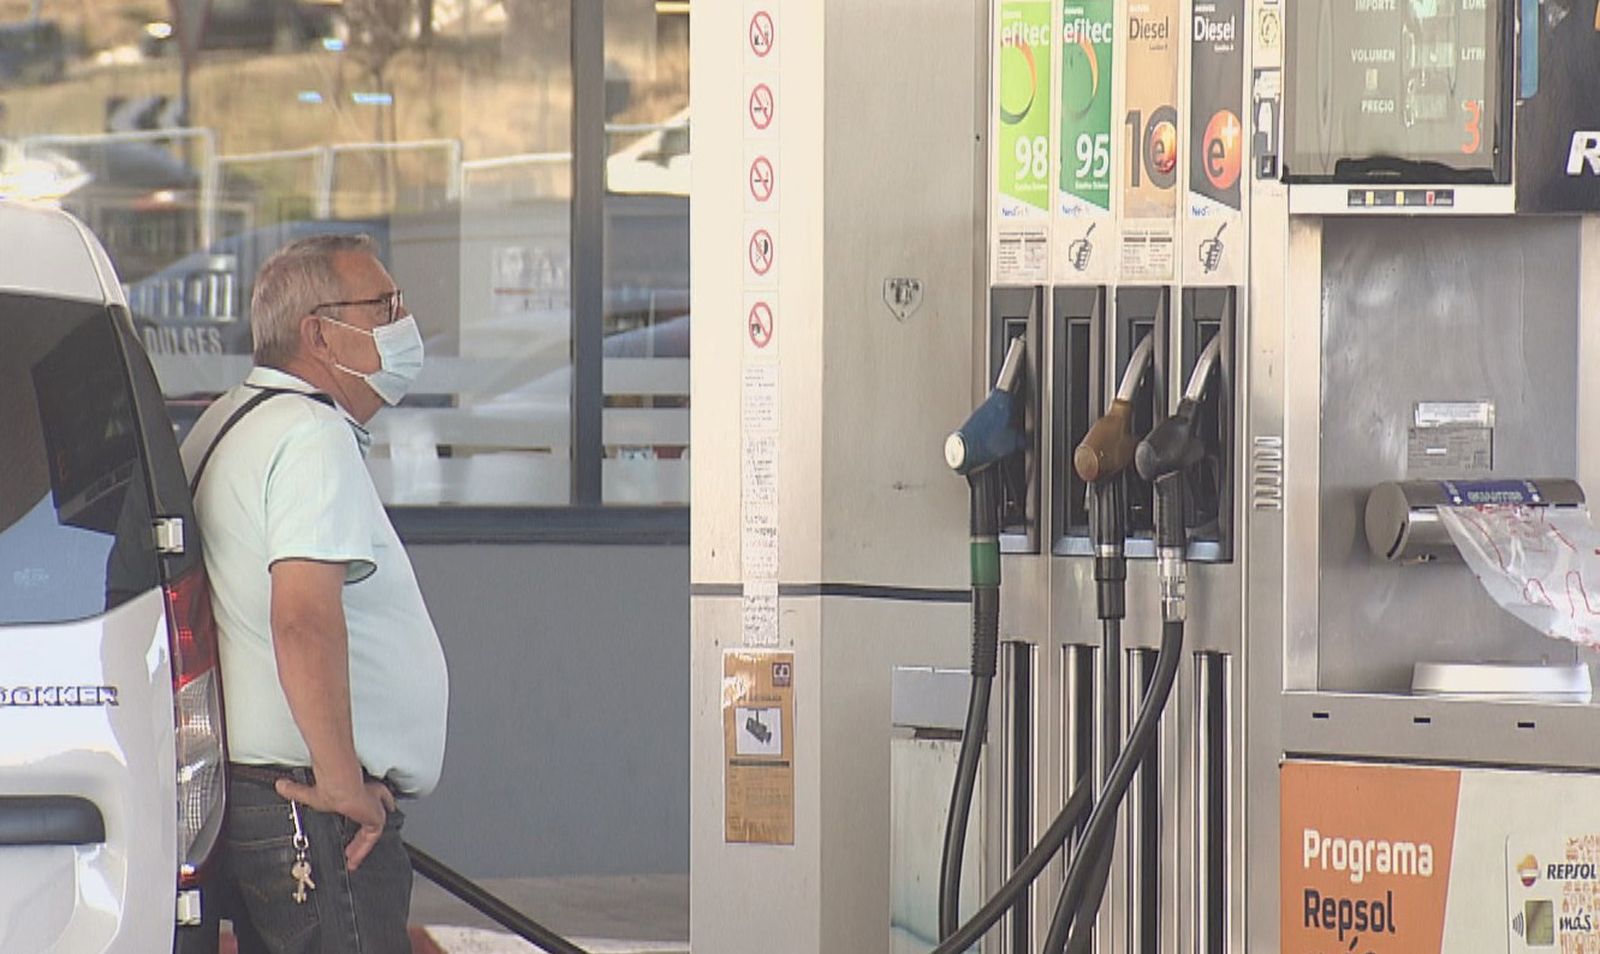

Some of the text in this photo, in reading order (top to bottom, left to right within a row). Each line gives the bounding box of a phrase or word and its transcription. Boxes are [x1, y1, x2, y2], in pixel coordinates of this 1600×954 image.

[1129, 16, 1169, 39] Diesel
[1194, 14, 1235, 41] Diesel
[1351, 48, 1396, 61] VOLUMEN
[1361, 99, 1395, 113] PRECIO
[1461, 99, 1480, 154] 3
[1014, 135, 1048, 180] 98
[1075, 133, 1110, 178] 95
[143, 326, 223, 355] DULCES
[1303, 828, 1433, 883] Programa
[1547, 863, 1597, 880] REPSOL
[1303, 888, 1396, 941] Repsol
